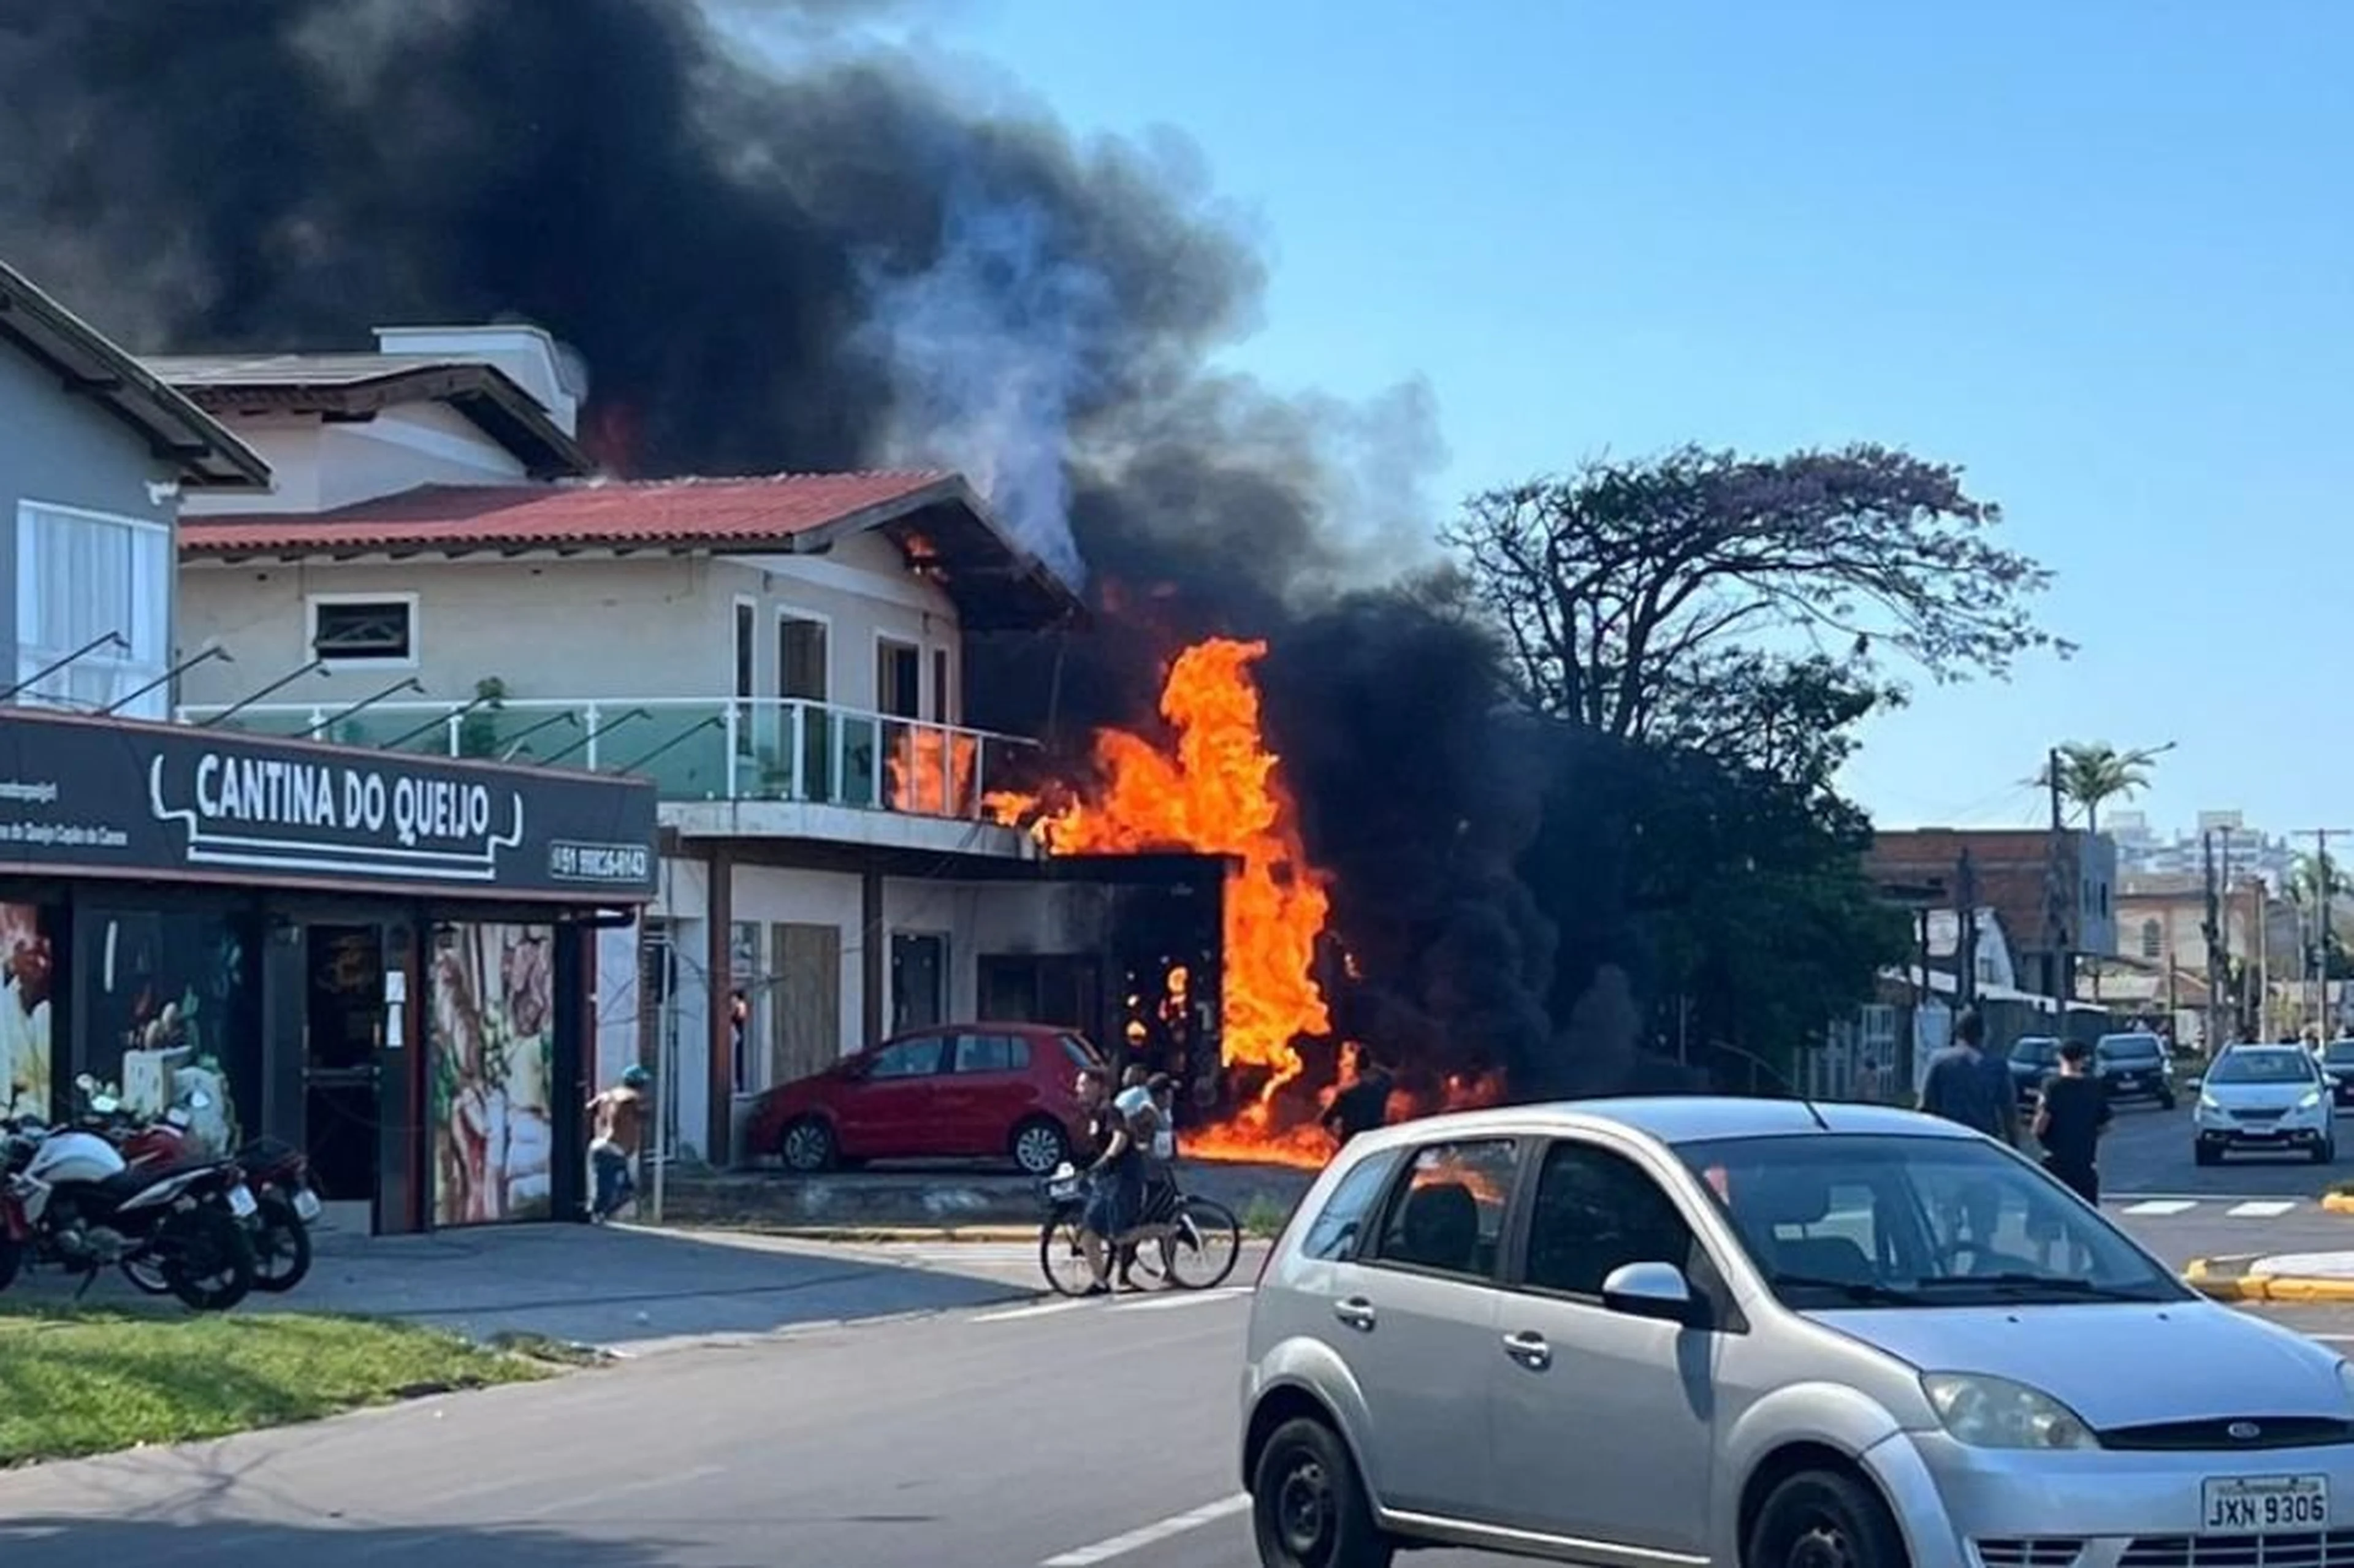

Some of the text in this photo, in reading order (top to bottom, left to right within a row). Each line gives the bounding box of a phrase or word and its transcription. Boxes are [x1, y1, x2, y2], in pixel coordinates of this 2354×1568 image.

[197, 754, 489, 845] CANTINA DO QUEIJO
[2209, 1494, 2325, 1527] JXN 9306
